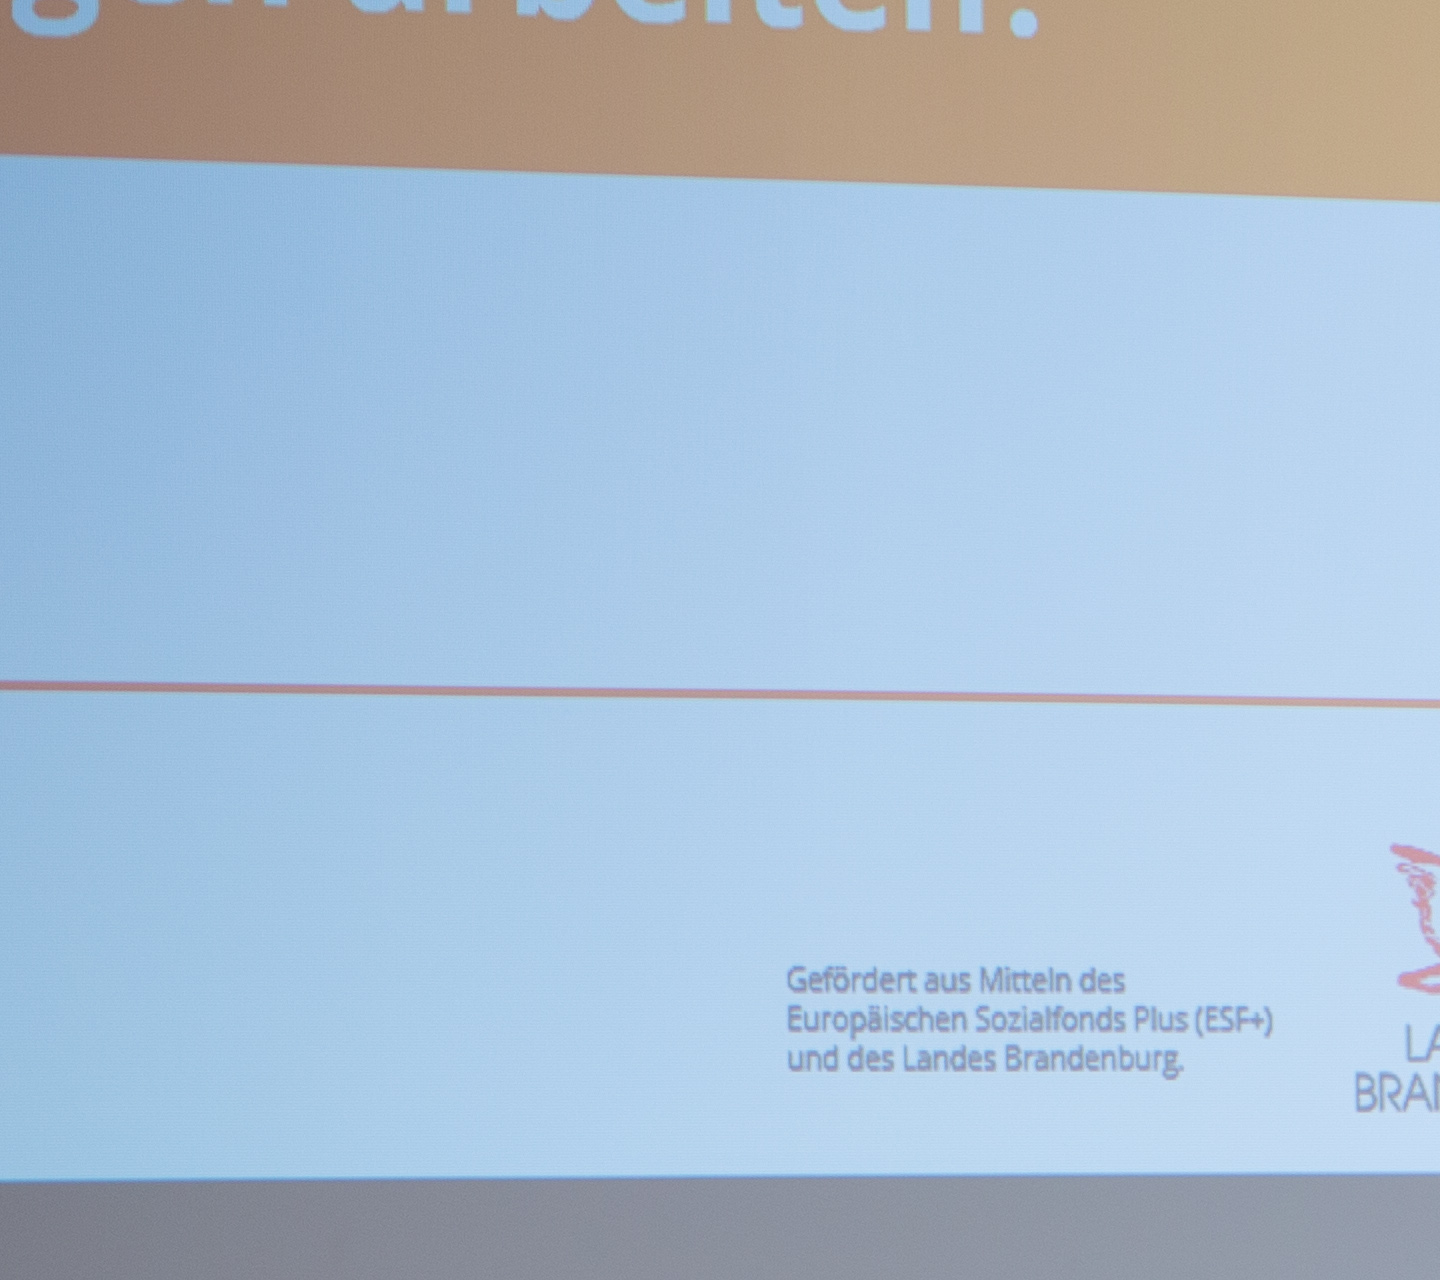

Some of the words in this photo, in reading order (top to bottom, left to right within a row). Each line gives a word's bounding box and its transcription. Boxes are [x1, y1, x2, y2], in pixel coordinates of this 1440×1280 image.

[787, 966, 917, 994] Gefördert
[925, 972, 971, 994] aus
[980, 966, 1072, 994] Mitteln
[1079, 967, 1126, 994] des
[787, 1005, 968, 1040] Europäischen
[975, 1005, 1126, 1033] Sozialfonds
[1134, 1006, 1189, 1033] Plus
[1195, 1006, 1275, 1039] (ESF+)
[787, 1045, 839, 1072] und
[847, 1045, 895, 1072] des
[903, 1045, 997, 1072] Landes
[1005, 1045, 1185, 1081] Brandenburg.
